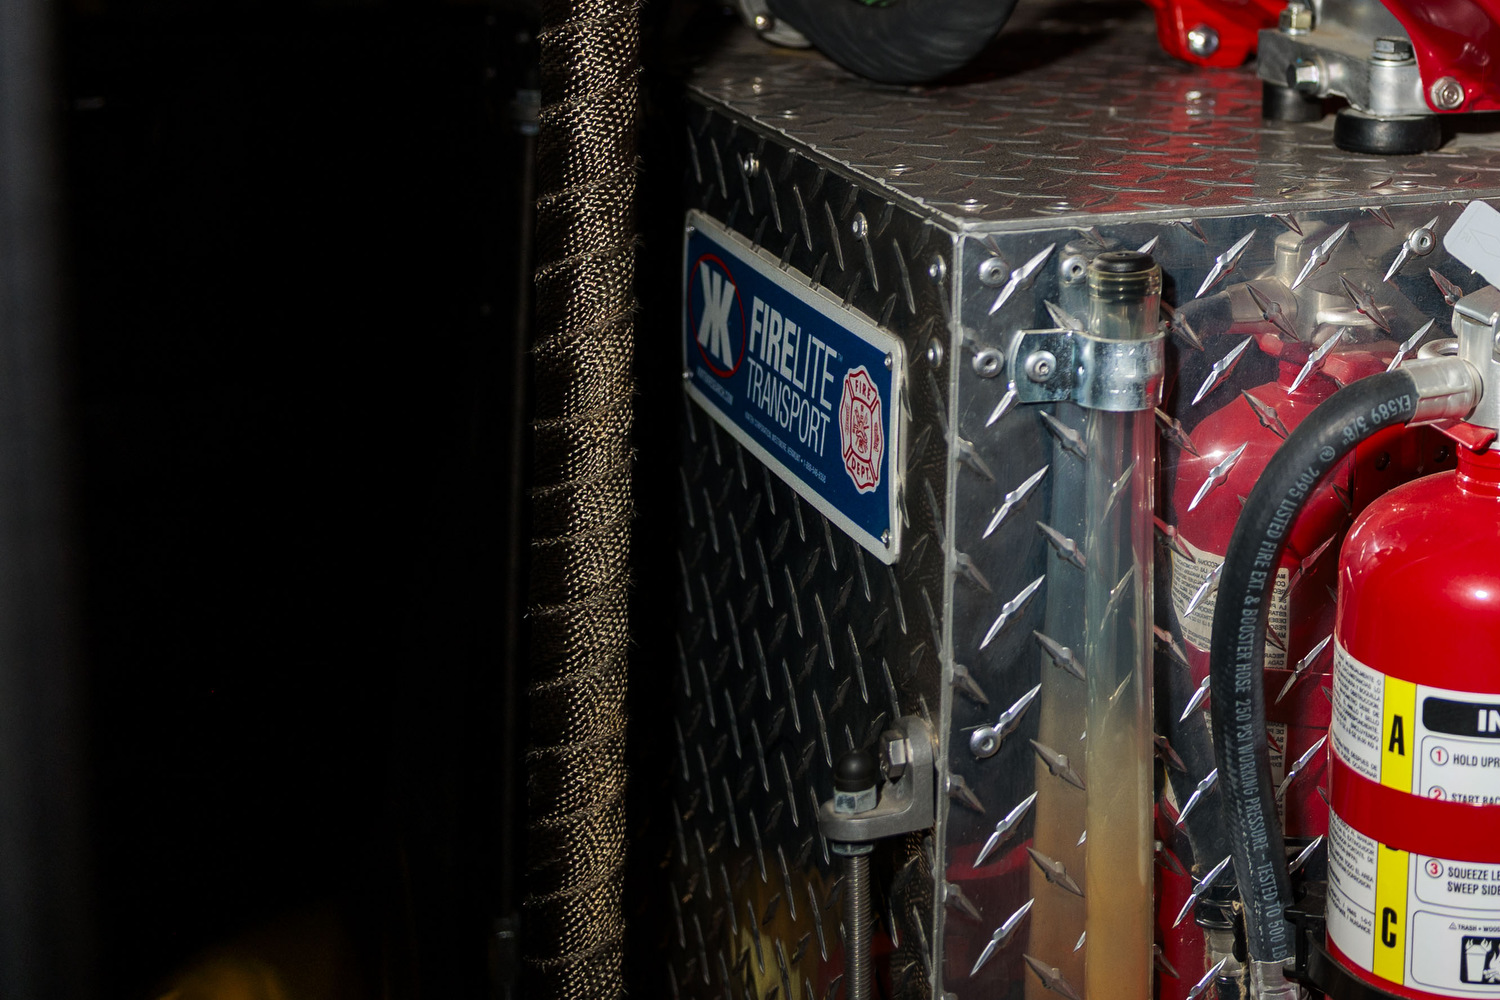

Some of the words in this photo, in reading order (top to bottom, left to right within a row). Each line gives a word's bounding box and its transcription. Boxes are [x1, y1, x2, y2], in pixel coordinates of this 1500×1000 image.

[748, 296, 838, 410] FIRELITE
[855, 380, 870, 400] FIRE
[746, 355, 831, 458] TRANSPORT
[1370, 394, 1411, 424] EX589
[1342, 416, 1369, 446] 3/8"
[851, 457, 871, 480] DEPT.
[1288, 467, 1320, 499] 2095
[1266, 499, 1298, 539] LISTED
[1254, 540, 1278, 568] FIRE
[1246, 570, 1267, 593] EXT.
[1243, 596, 1260, 606] &
[1236, 608, 1259, 660] BOOSTER
[1235, 664, 1252, 693] HOSE
[1235, 699, 1252, 721] 250
[1236, 725, 1253, 742] PSI
[1388, 714, 1405, 756] A
[1238, 744, 1260, 796] WORKING
[1453, 753, 1478, 767] HOLD
[1244, 796, 1269, 851] PRESSURE
[1257, 861, 1278, 901] TESTED
[1447, 881, 1479, 895] SWEEP
[1448, 866, 1488, 881] SQUEEZE
[1265, 900, 1281, 918] TO
[1268, 919, 1286, 943] 500
[1382, 906, 1397, 948] C
